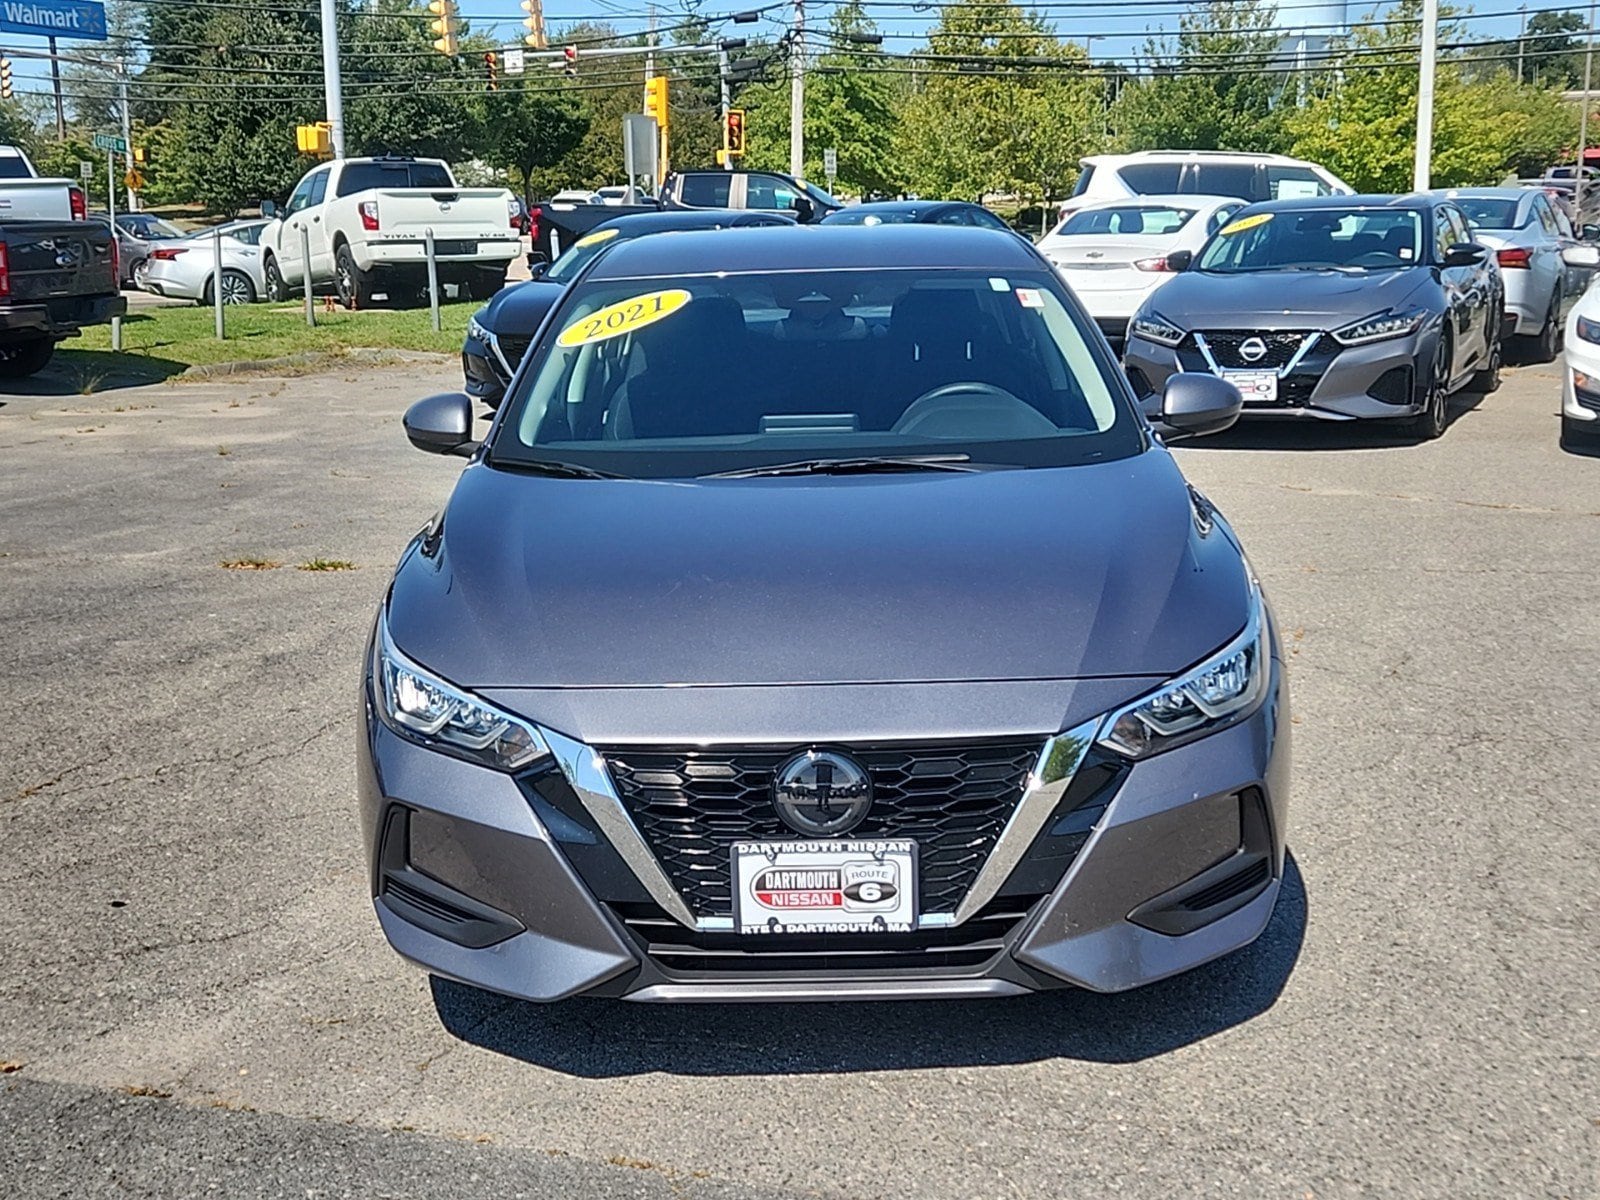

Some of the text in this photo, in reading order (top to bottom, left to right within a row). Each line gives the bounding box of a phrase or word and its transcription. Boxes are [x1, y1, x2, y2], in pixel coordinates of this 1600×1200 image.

[3, 1, 80, 28] Walmart
[584, 295, 665, 339] 2021
[737, 841, 912, 854] DARTMOUTH NISSAN
[765, 871, 839, 890] DARTMOUTH
[851, 870, 888, 880] ROUTE
[771, 893, 834, 907] NISSAN
[858, 882, 882, 902] 6
[741, 925, 770, 935] RTE
[773, 924, 783, 934] 6
[886, 922, 911, 932] MA
